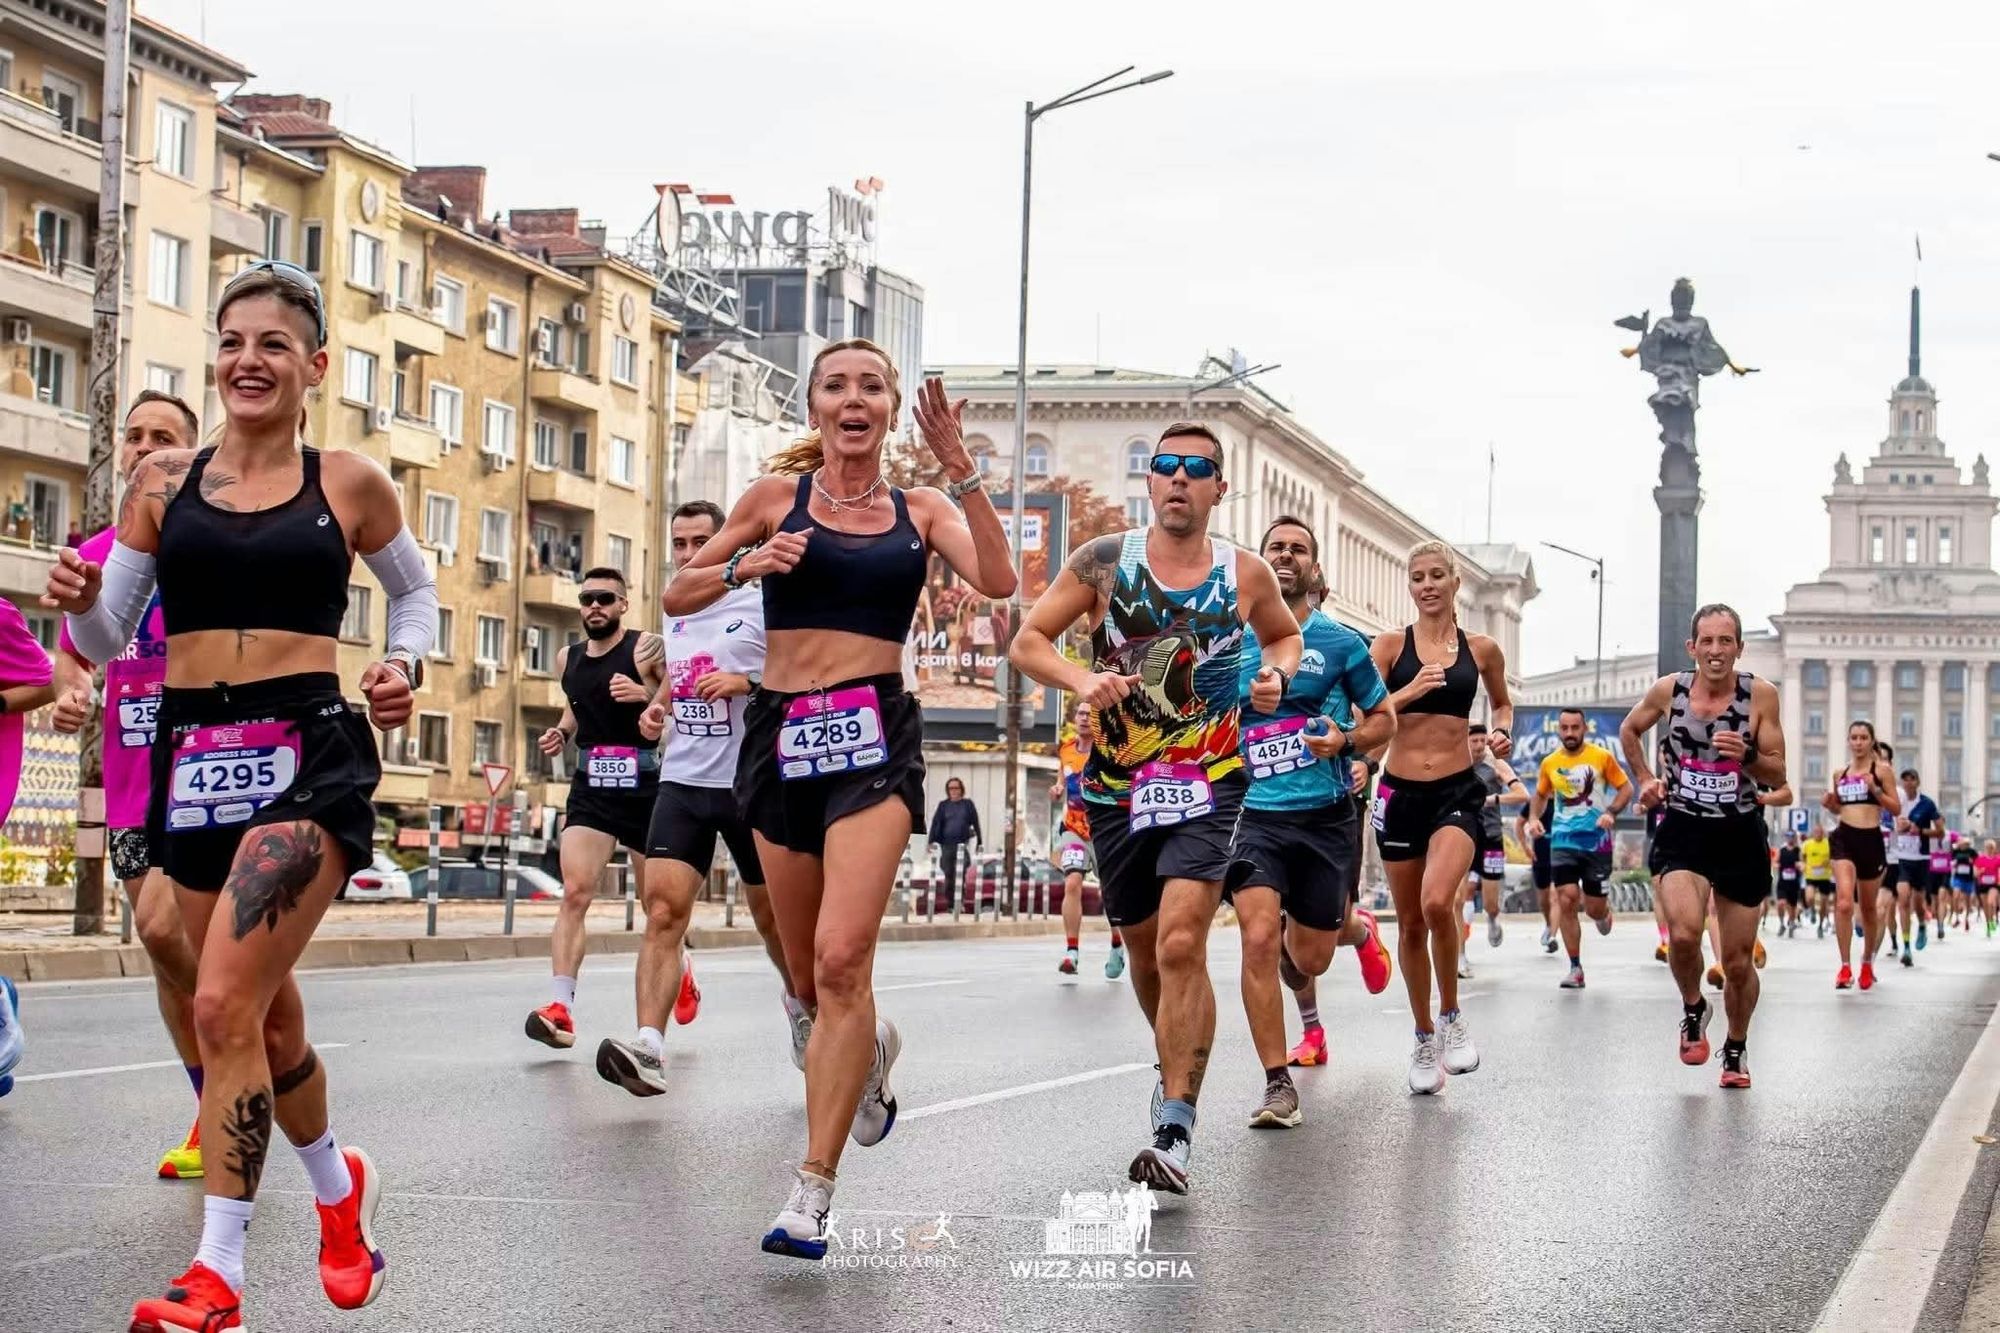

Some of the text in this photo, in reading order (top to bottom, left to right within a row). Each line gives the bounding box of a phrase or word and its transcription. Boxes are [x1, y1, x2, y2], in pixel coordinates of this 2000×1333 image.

[140, 641, 167, 658] SO
[132, 707, 157, 724] 25
[681, 705, 714, 719] 2381
[793, 720, 861, 749] 4289
[240, 749, 259, 758] RUN
[1258, 737, 1302, 760] 4874
[594, 762, 626, 773] 3850
[188, 761, 275, 793] 4295
[1689, 774, 1717, 789] 343
[1141, 787, 1194, 805] 4838
[1791, 811, 1803, 829] P
